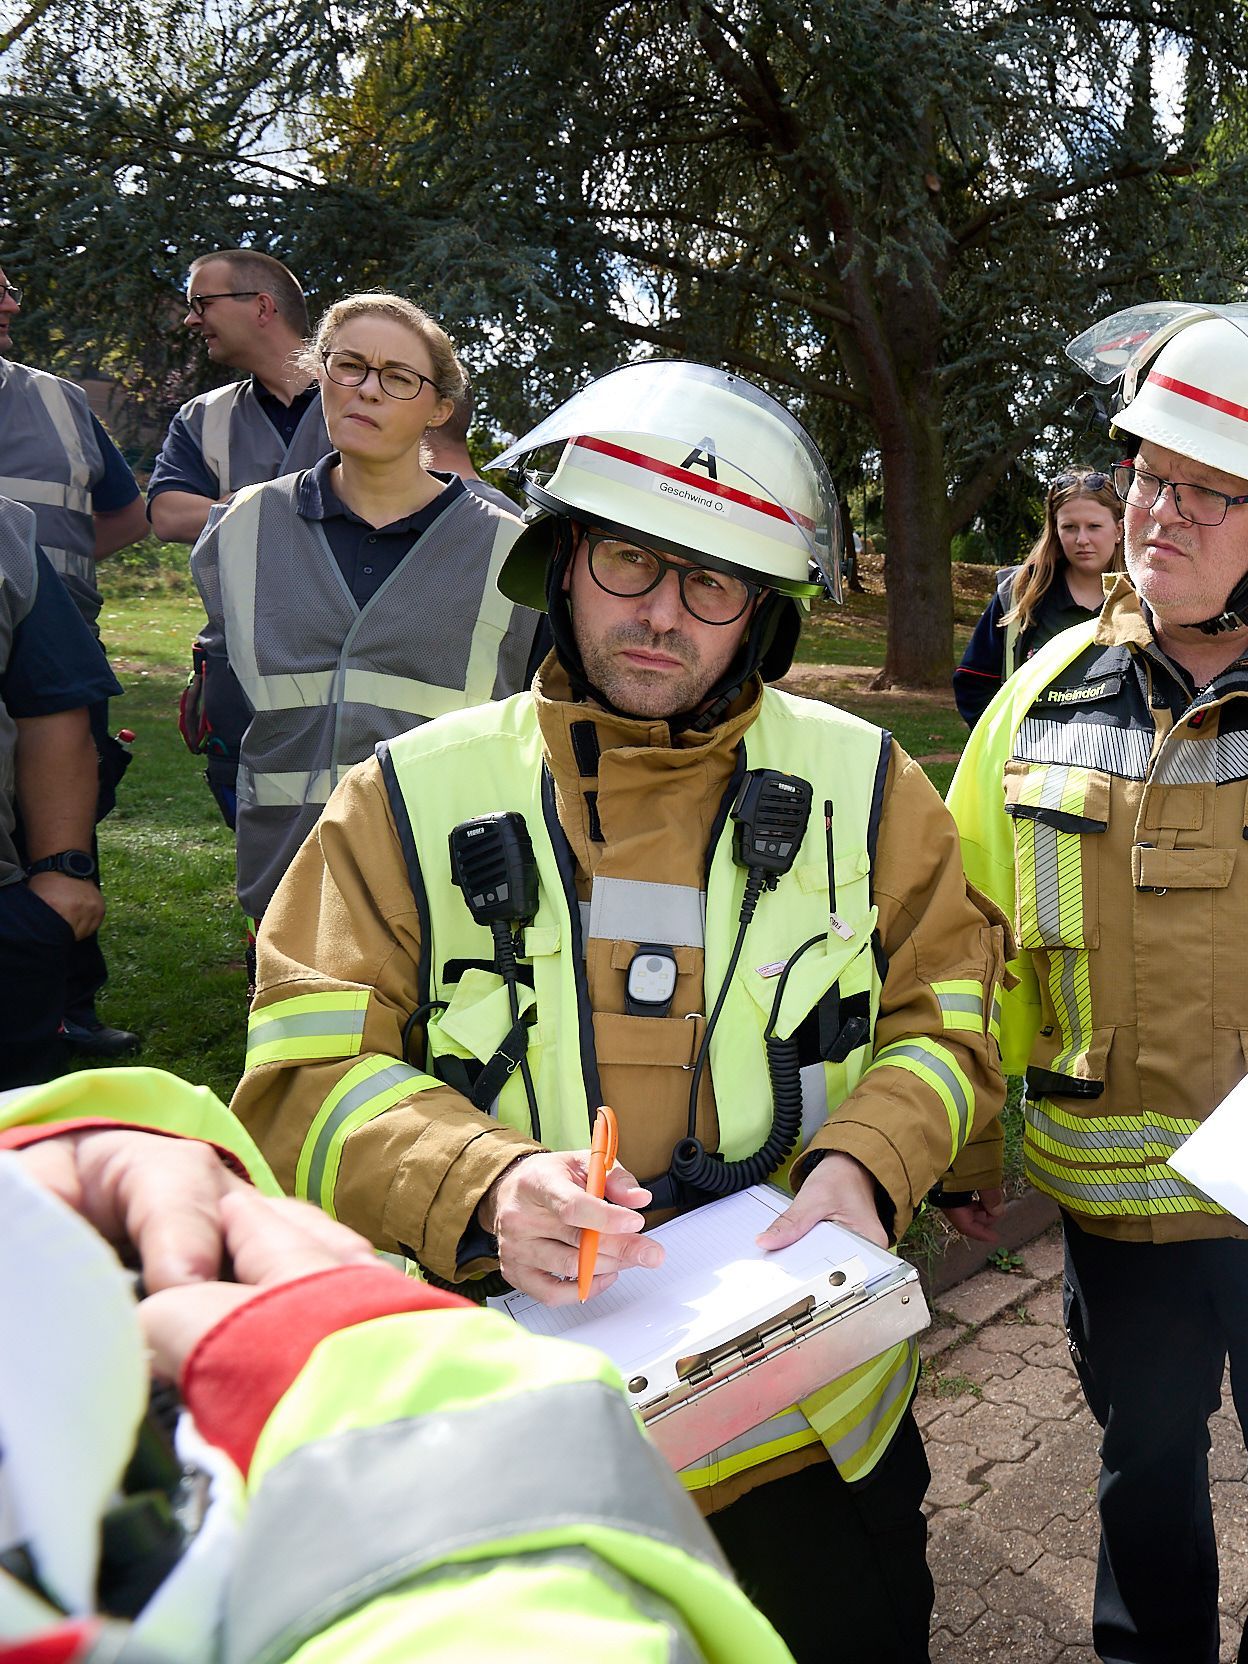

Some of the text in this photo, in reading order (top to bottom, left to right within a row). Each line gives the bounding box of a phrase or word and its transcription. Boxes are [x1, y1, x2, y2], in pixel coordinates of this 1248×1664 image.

[680, 436, 717, 480] A
[659, 482, 725, 513] Geschwind O.
[1047, 682, 1106, 703] Rheindorf
